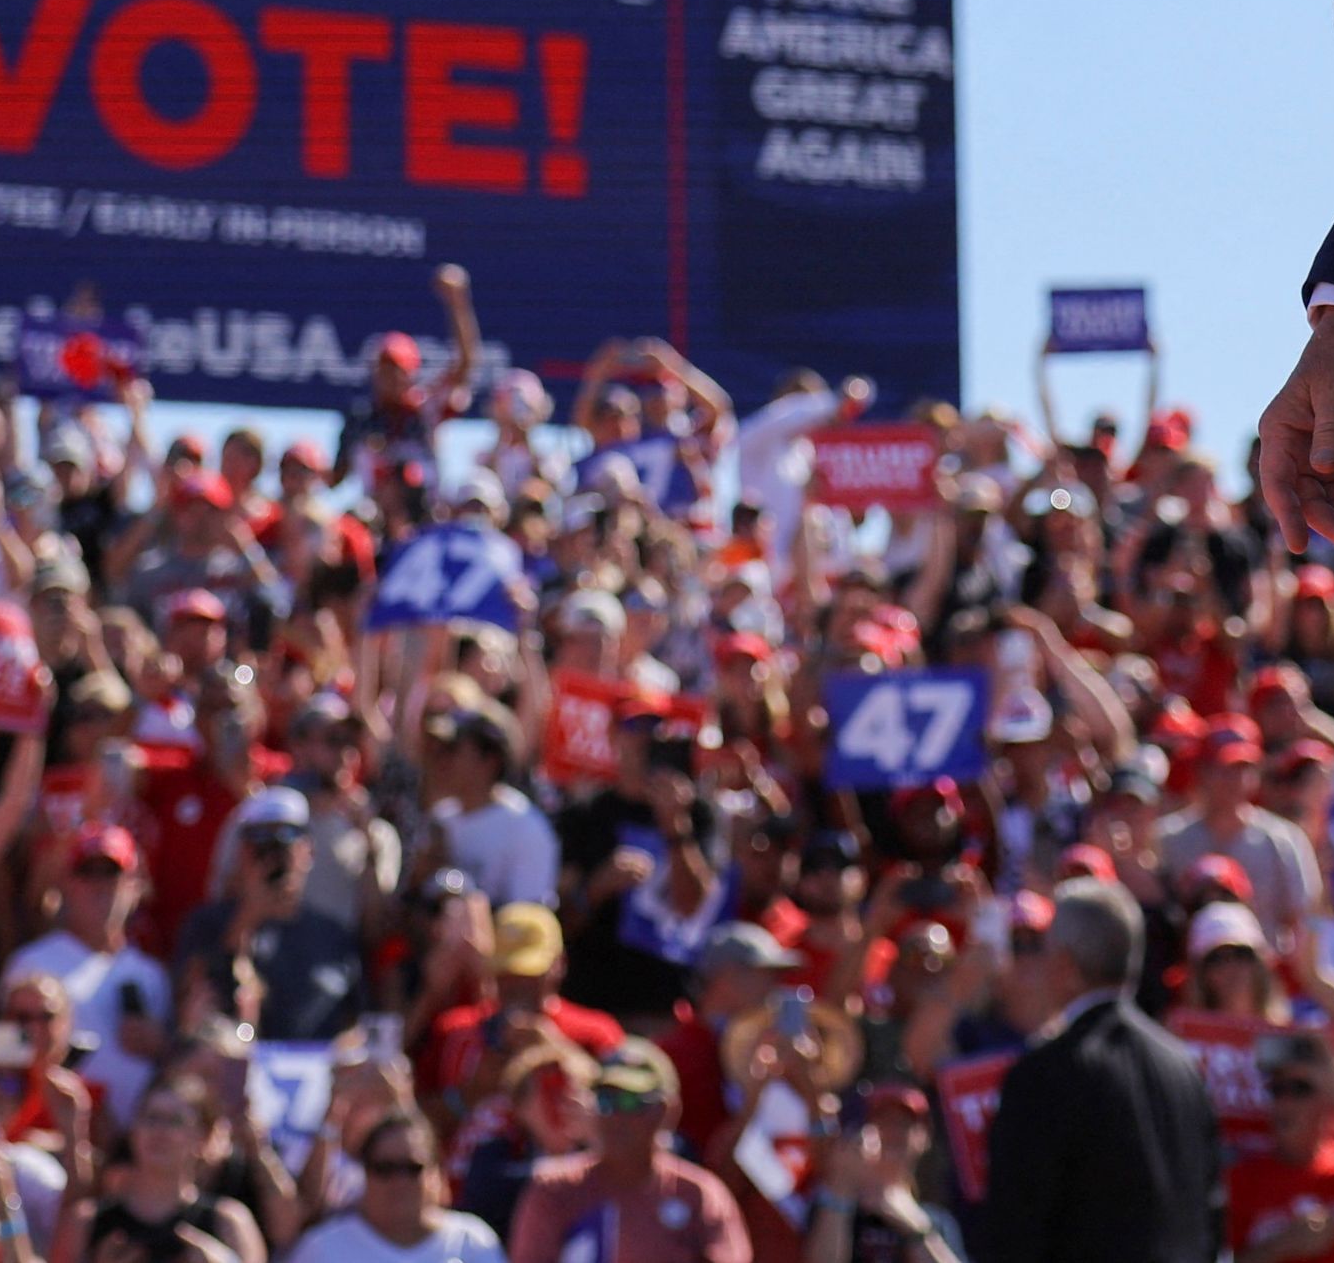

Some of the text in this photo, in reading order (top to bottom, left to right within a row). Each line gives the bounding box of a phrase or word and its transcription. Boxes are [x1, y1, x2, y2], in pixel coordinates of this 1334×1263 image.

[719, 5, 954, 81] AMERICA
[751, 66, 929, 132] GREAT
[756, 127, 926, 193] AGAIN
[93, 191, 215, 242] EARLY
[218, 201, 426, 259] IN-PERSON
[379, 536, 509, 614] 47
[837, 681, 973, 770] 47
